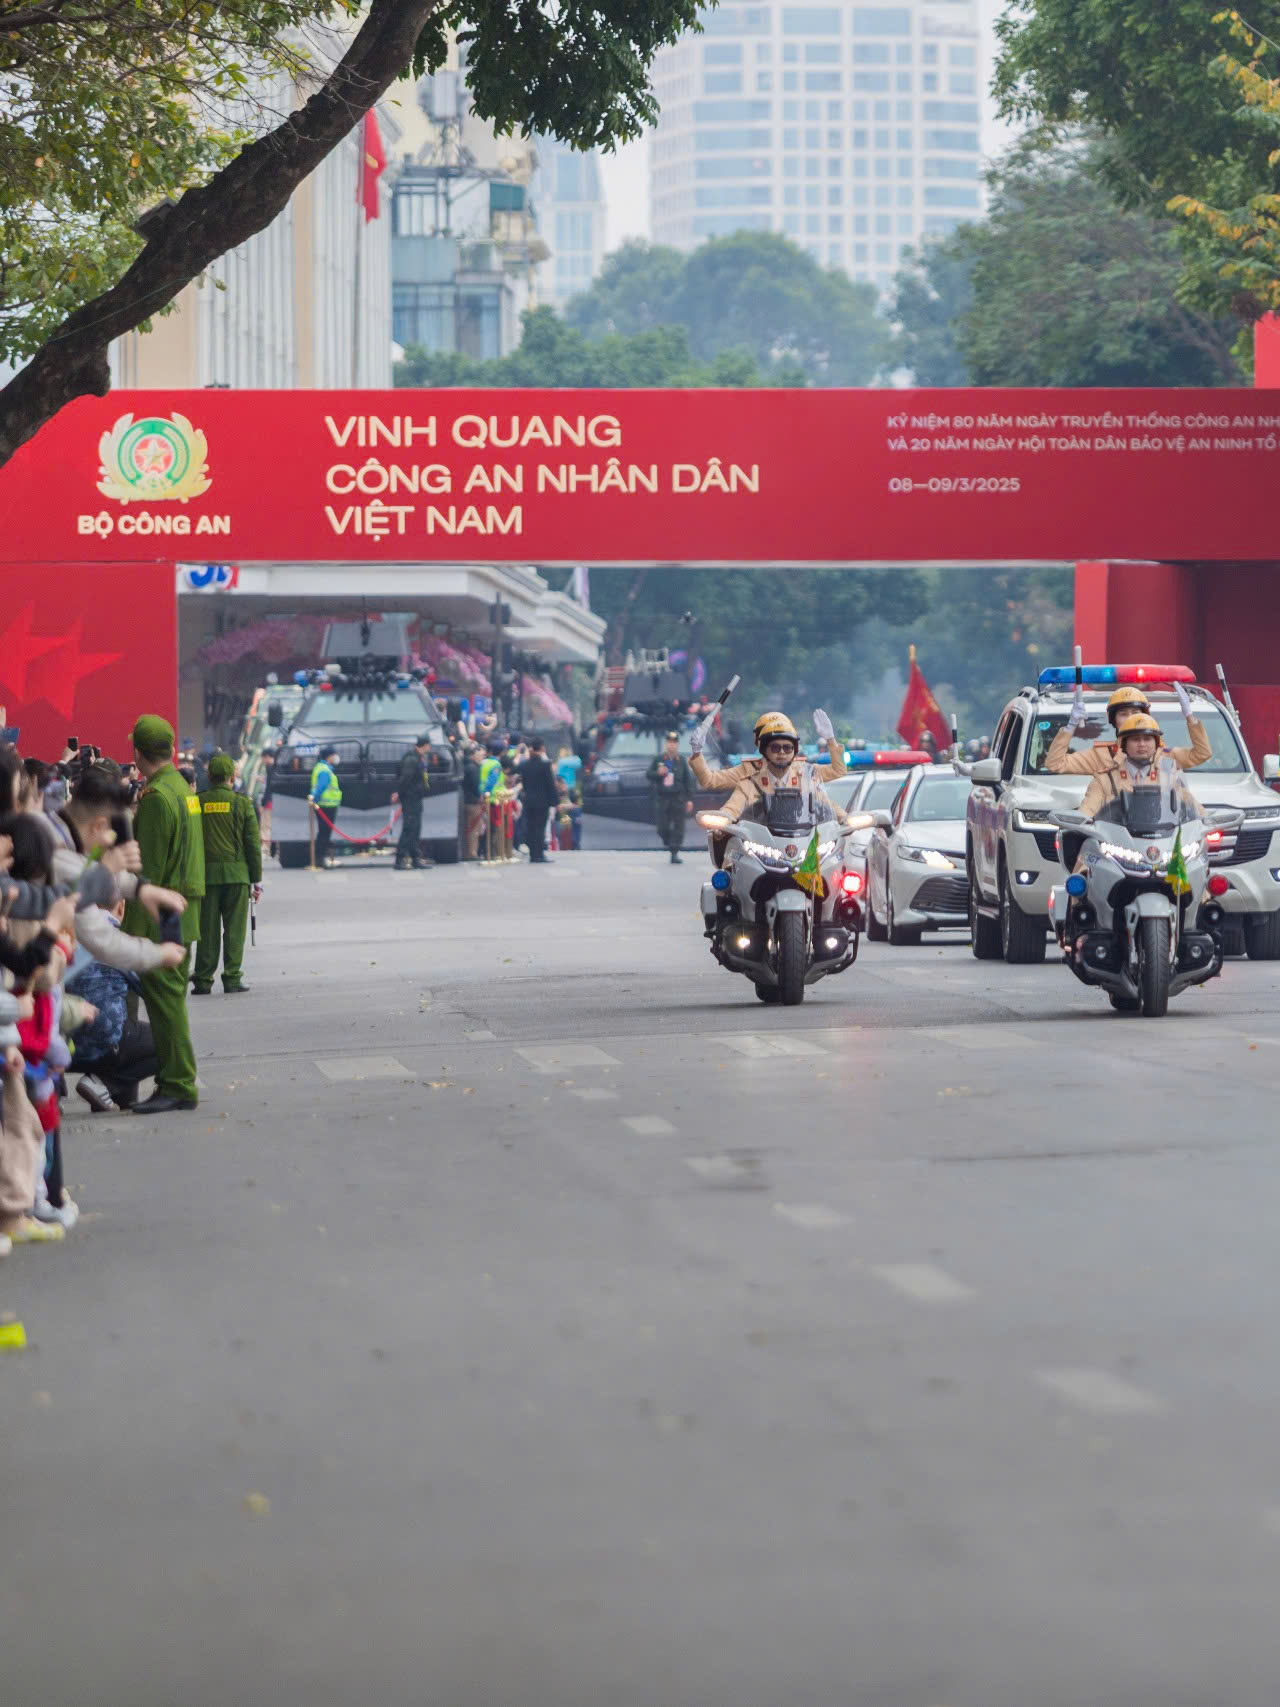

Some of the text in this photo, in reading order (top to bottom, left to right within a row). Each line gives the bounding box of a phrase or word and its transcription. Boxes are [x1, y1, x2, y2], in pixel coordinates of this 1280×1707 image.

[324, 414, 622, 449] VINH QUANG
[886, 411, 908, 428] KỶ
[910, 412, 950, 430] NIỆM
[952, 414, 974, 429] 80
[976, 413, 1012, 428] NĂM
[1014, 412, 1057, 428] NGÀY
[1059, 411, 1123, 428] TRUYỀN
[1126, 411, 1182, 428] THỐNG
[1184, 412, 1230, 429] CÔNG
[1232, 415, 1254, 428] AN
[887, 434, 908, 450] VÀ
[911, 437, 931, 451] 20
[933, 435, 970, 450] NĂM
[973, 434, 1013, 450] NGÀY
[1018, 435, 1046, 453] HỘI
[1049, 434, 1091, 450] TOÀN
[1094, 435, 1127, 450] DÂN
[1130, 433, 1163, 450] BẢO
[1165, 435, 1186, 453] VỆ
[1188, 437, 1211, 450] AN
[1214, 437, 1253, 450] NINH
[1255, 433, 1277, 449] TỔ
[325, 456, 760, 495] CÔNG AN NHÂN DÂN
[77, 510, 231, 540] BỘ CÔNG AN
[324, 498, 523, 543] VIỆT NAM
